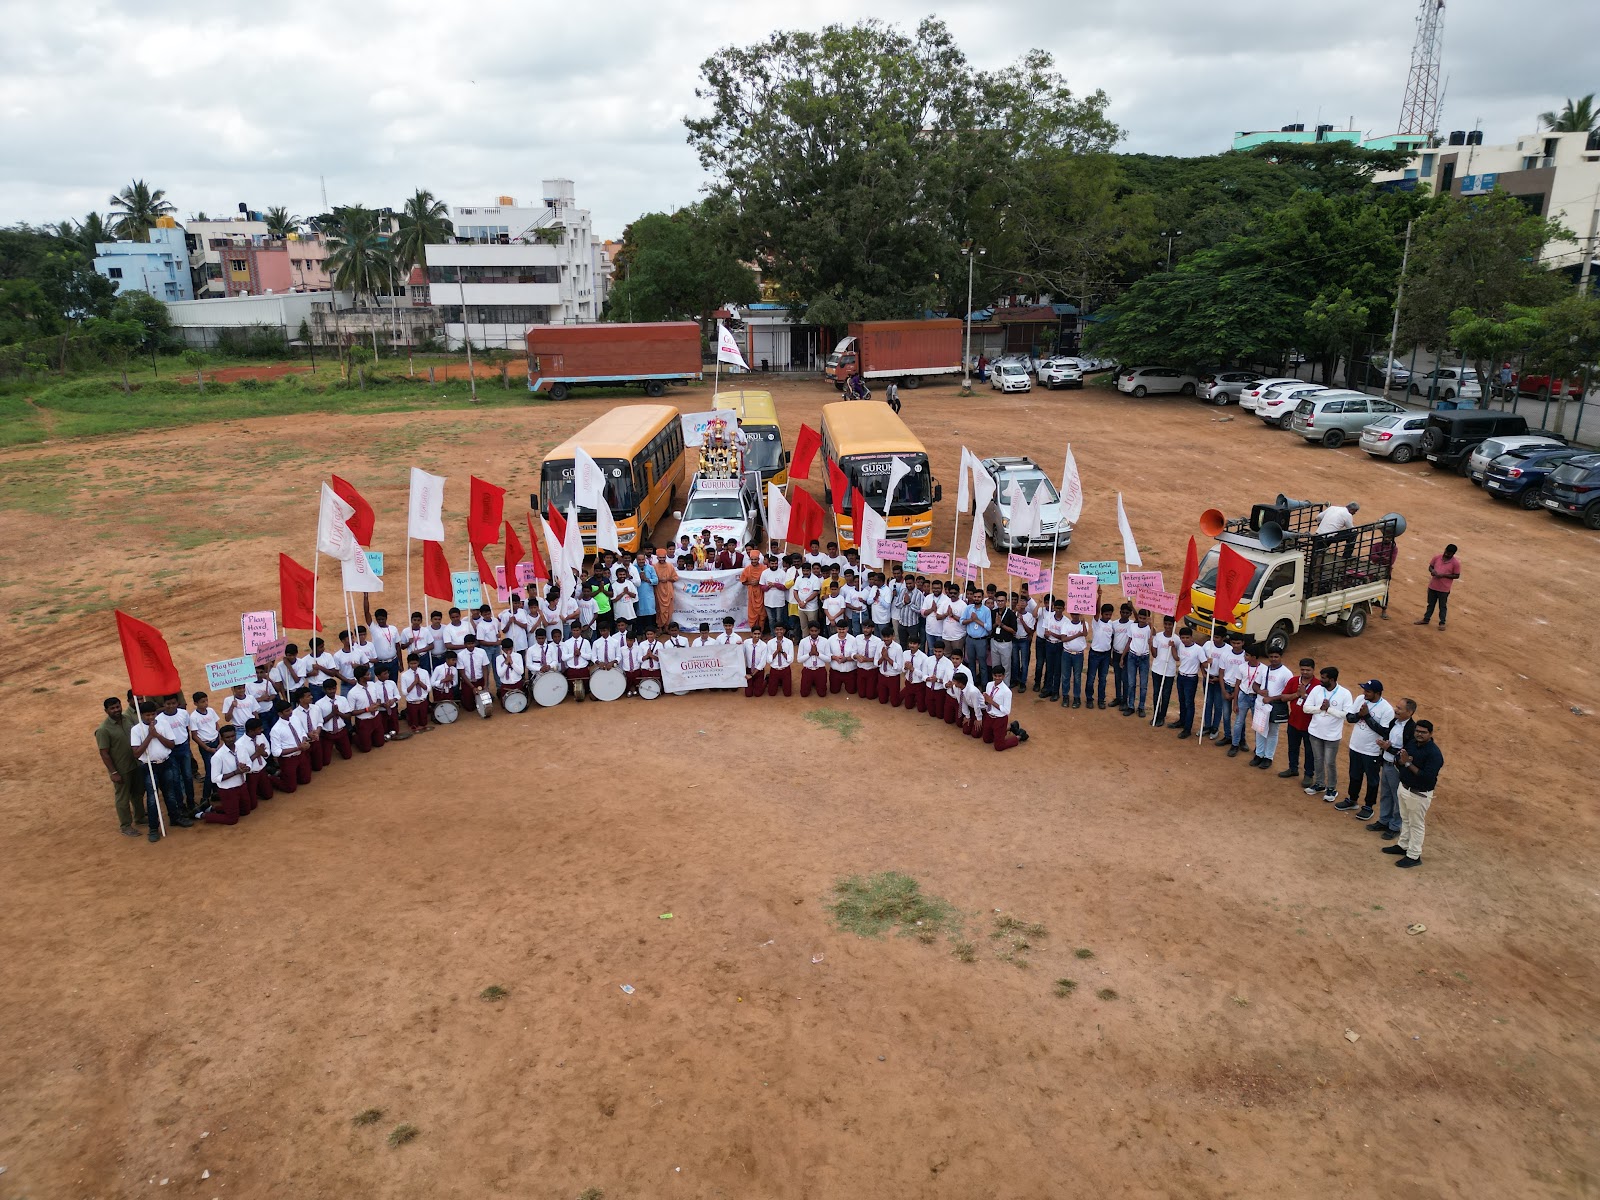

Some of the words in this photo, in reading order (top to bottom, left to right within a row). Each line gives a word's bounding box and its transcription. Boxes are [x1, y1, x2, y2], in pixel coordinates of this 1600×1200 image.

[861, 463, 892, 472] GURUK
[701, 481, 738, 489] GURUKUL
[681, 659, 723, 670] GURUKUL
